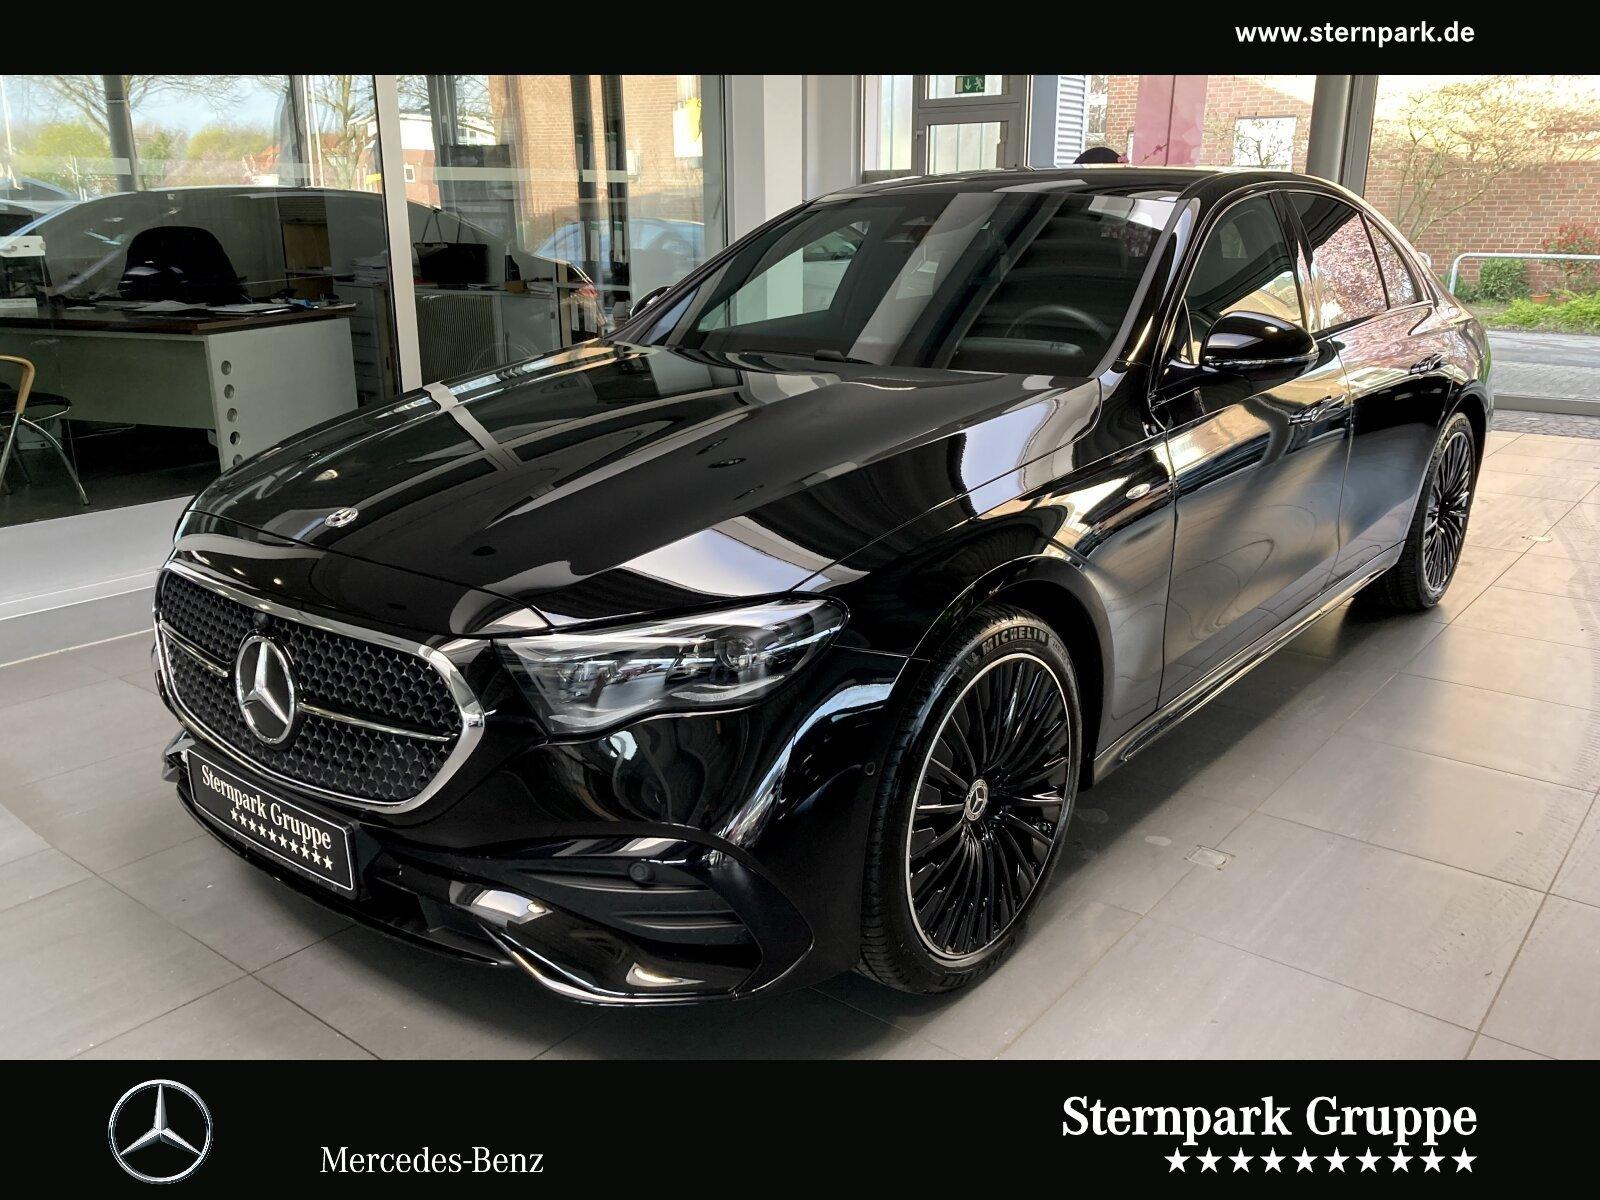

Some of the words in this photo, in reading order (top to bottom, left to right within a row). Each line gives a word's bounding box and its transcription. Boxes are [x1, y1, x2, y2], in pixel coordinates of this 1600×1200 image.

[982, 627, 1047, 654] MICHELIN
[202, 764, 267, 819] Sternpark
[270, 803, 332, 850] Gruppe
